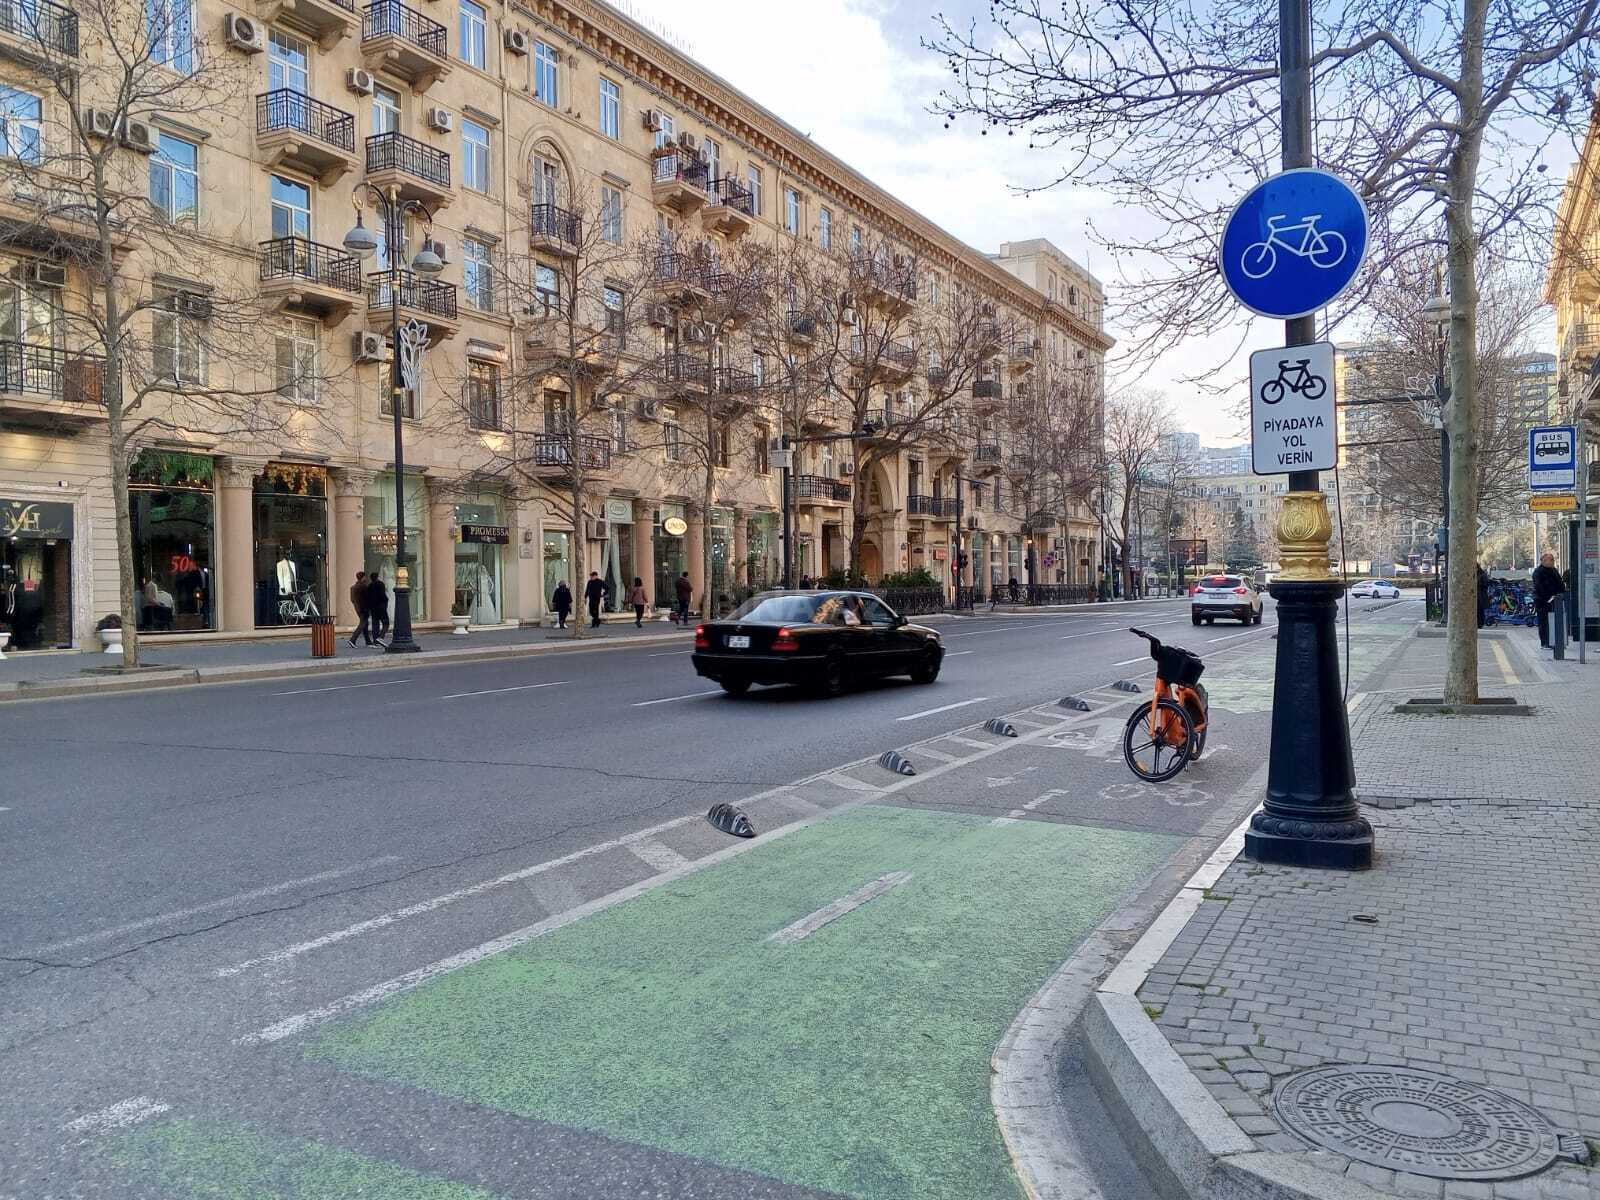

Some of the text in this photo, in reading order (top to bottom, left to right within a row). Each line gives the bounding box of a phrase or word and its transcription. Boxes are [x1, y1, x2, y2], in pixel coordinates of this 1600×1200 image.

[1264, 415, 1324, 433] PİYADAYA
[1282, 434, 1307, 448] YOL
[1541, 433, 1563, 441] BUS
[1277, 449, 1313, 465] VERİN
[470, 526, 510, 537] PROMESSA
